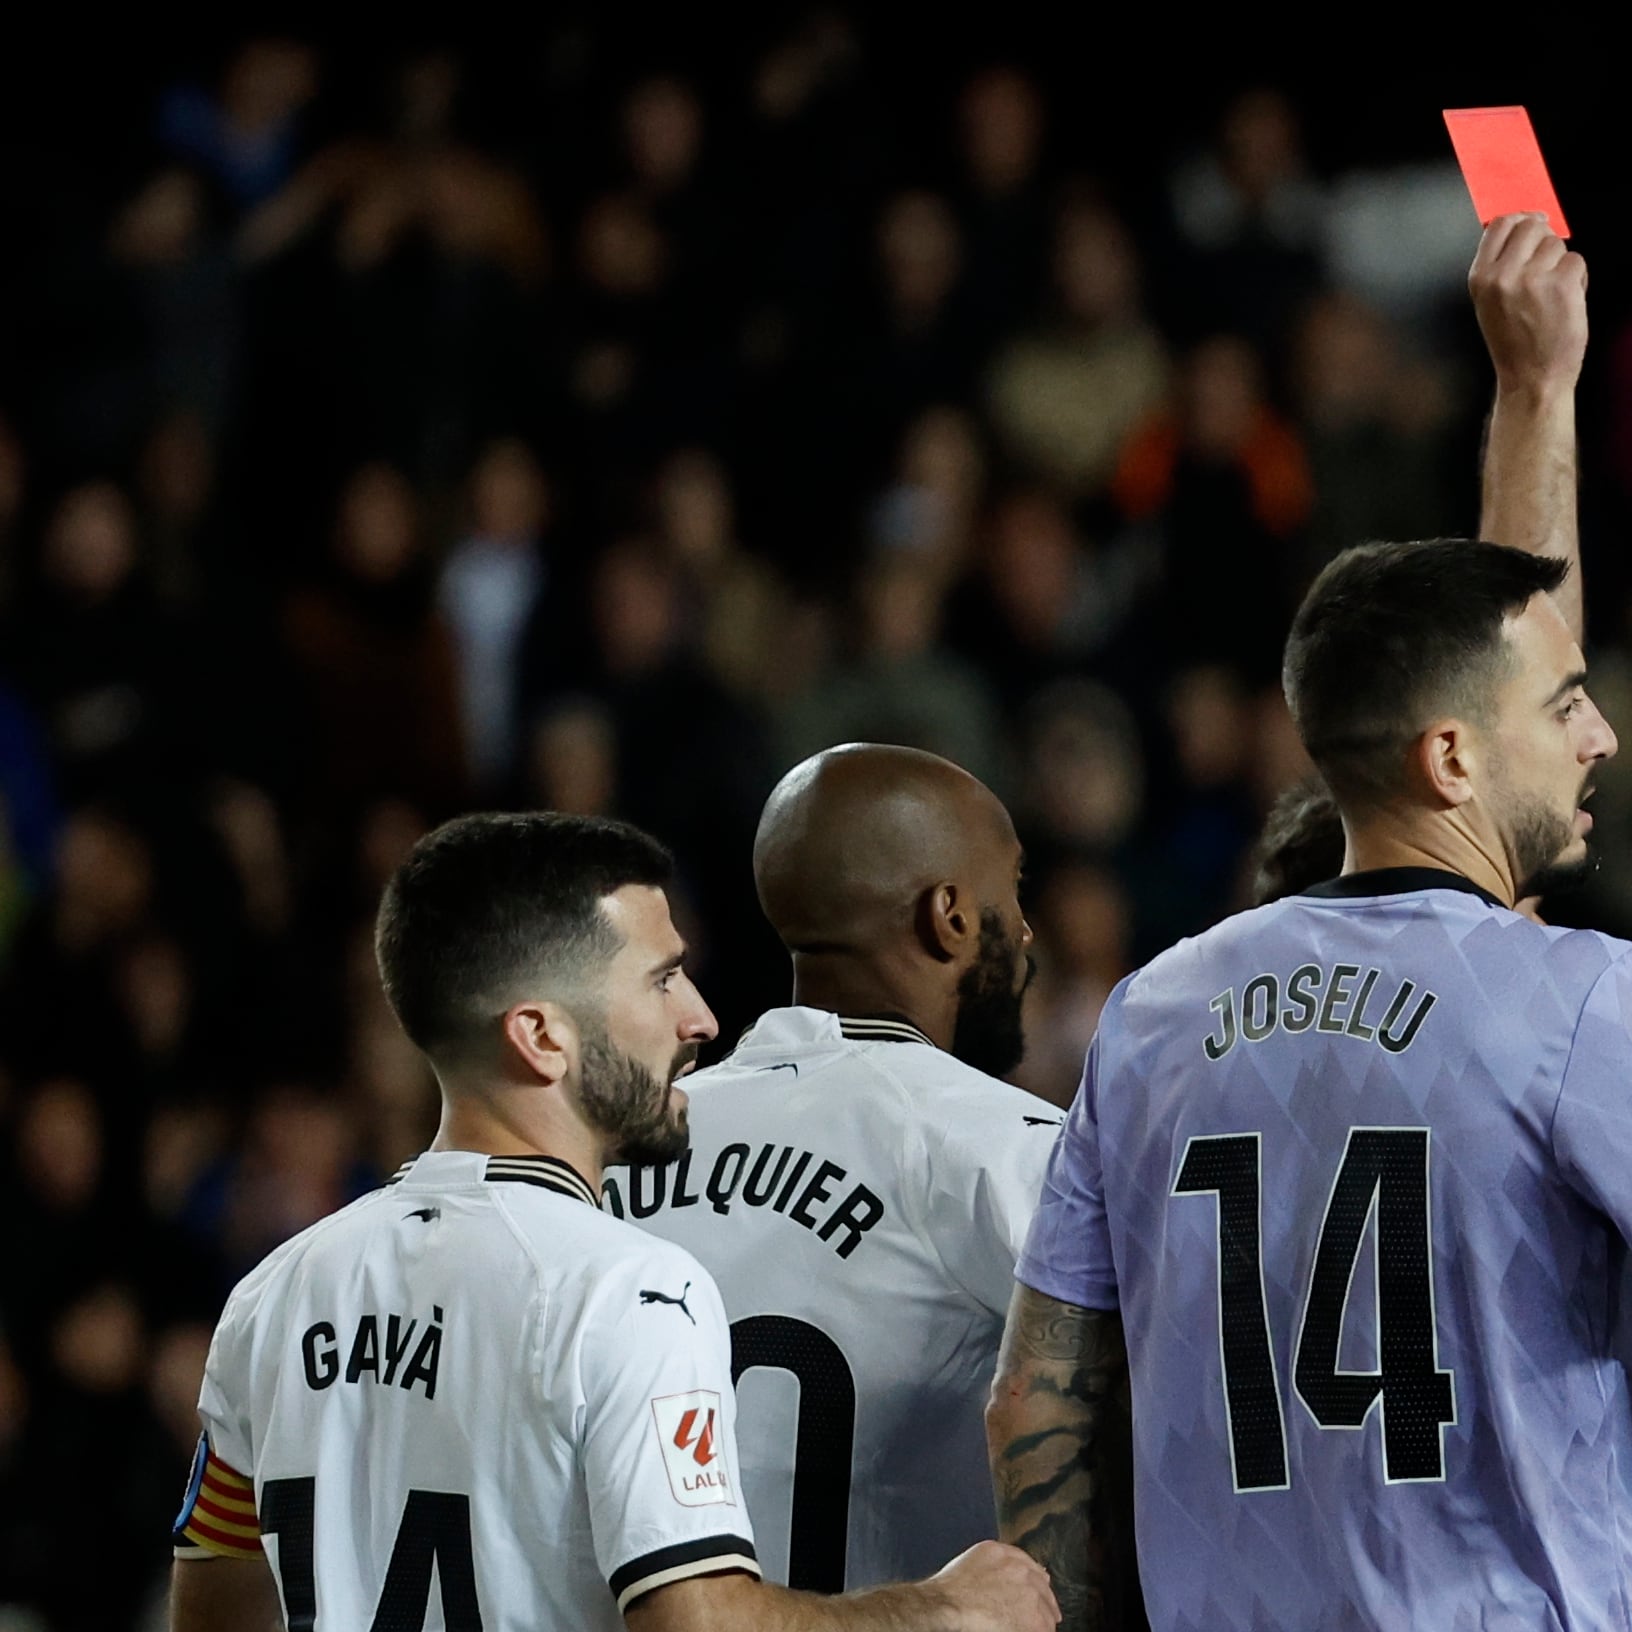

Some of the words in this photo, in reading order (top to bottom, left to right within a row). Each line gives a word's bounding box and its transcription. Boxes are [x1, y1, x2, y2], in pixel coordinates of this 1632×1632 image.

[1202, 963, 1438, 1060] JOSELU
[302, 1304, 444, 1401] GAYÀ
[1171, 1126, 1458, 1494] 14
